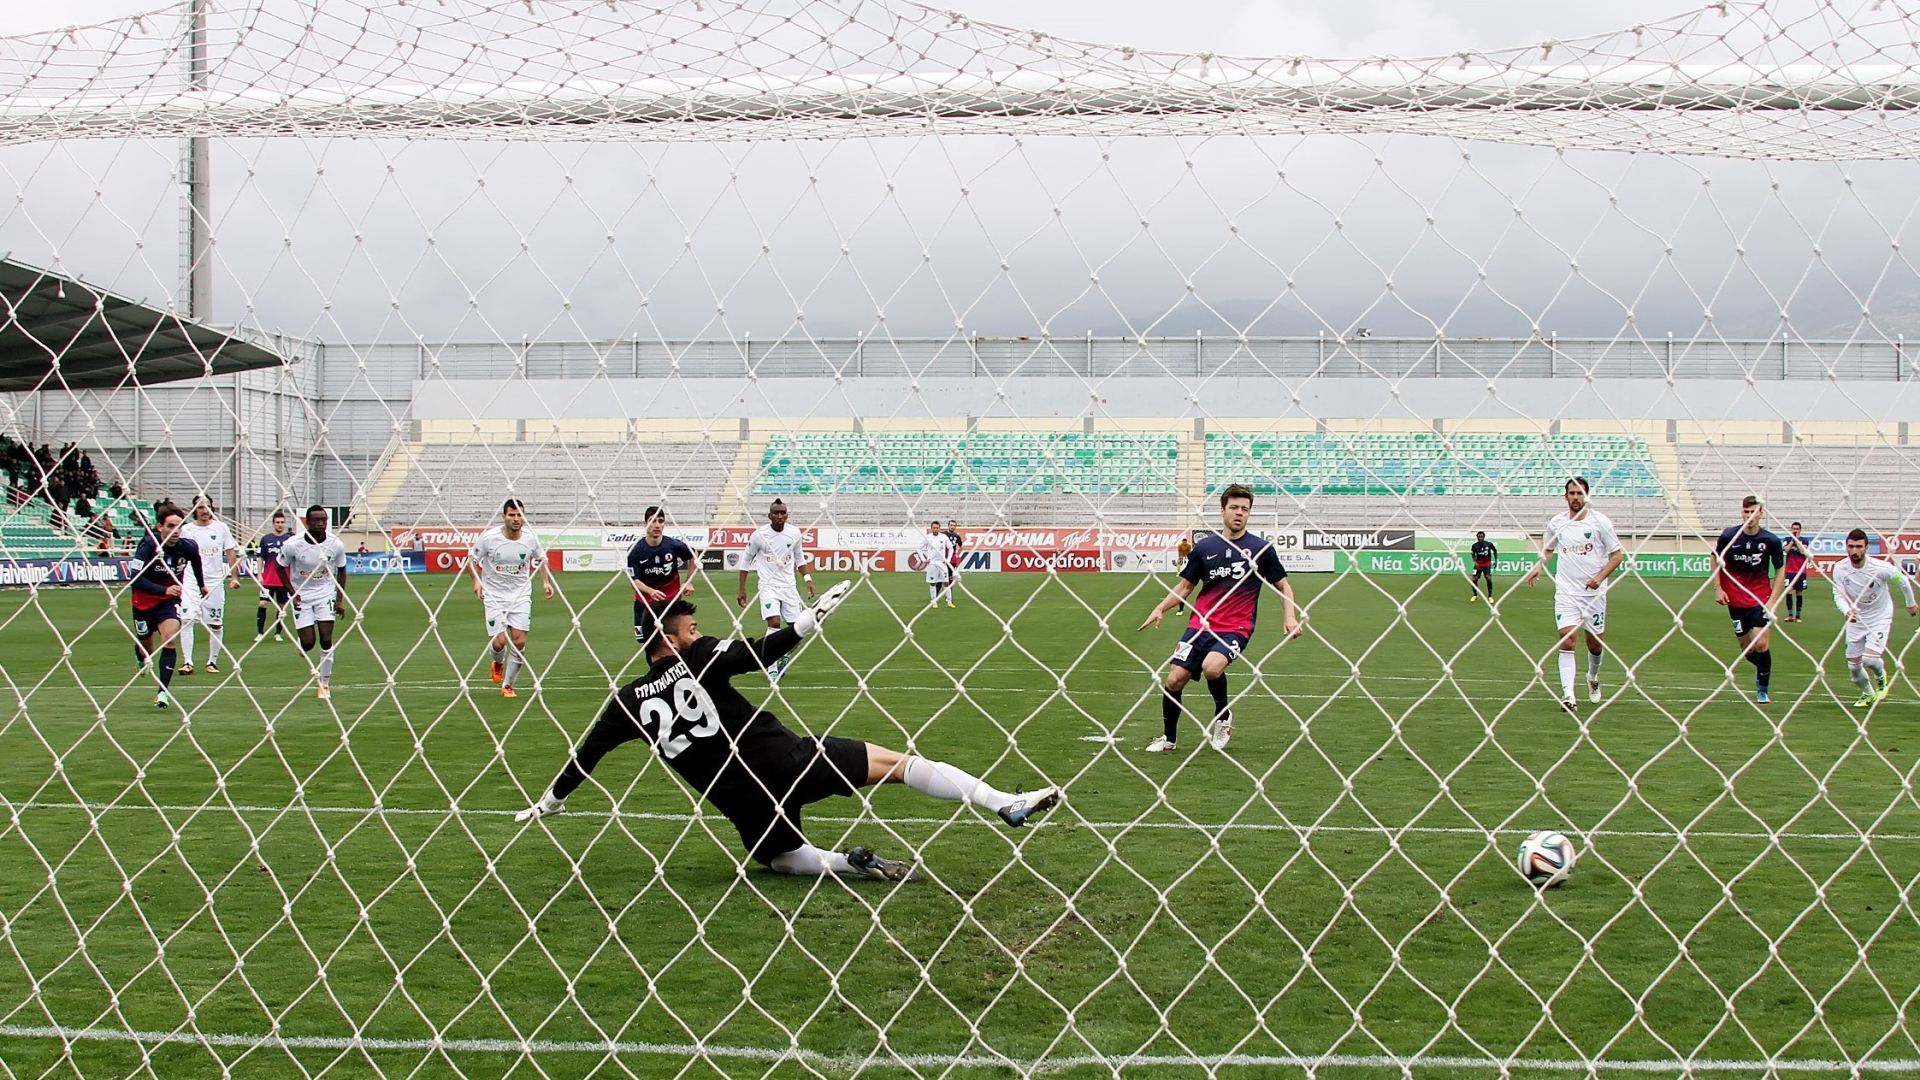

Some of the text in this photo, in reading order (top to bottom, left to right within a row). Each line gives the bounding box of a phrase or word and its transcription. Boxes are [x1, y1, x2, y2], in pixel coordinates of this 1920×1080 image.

[421, 532, 482, 545] ΣΤΟΙΧΗΜ
[607, 533, 645, 542] Golda
[796, 551, 885, 572] Public
[1023, 553, 1105, 569] vodafone
[1231, 560, 1246, 580] 3
[1490, 556, 1534, 571] tavia
[1683, 557, 1712, 572] Κάθ
[69, 561, 119, 582] Valvoline
[639, 677, 720, 760] 29
